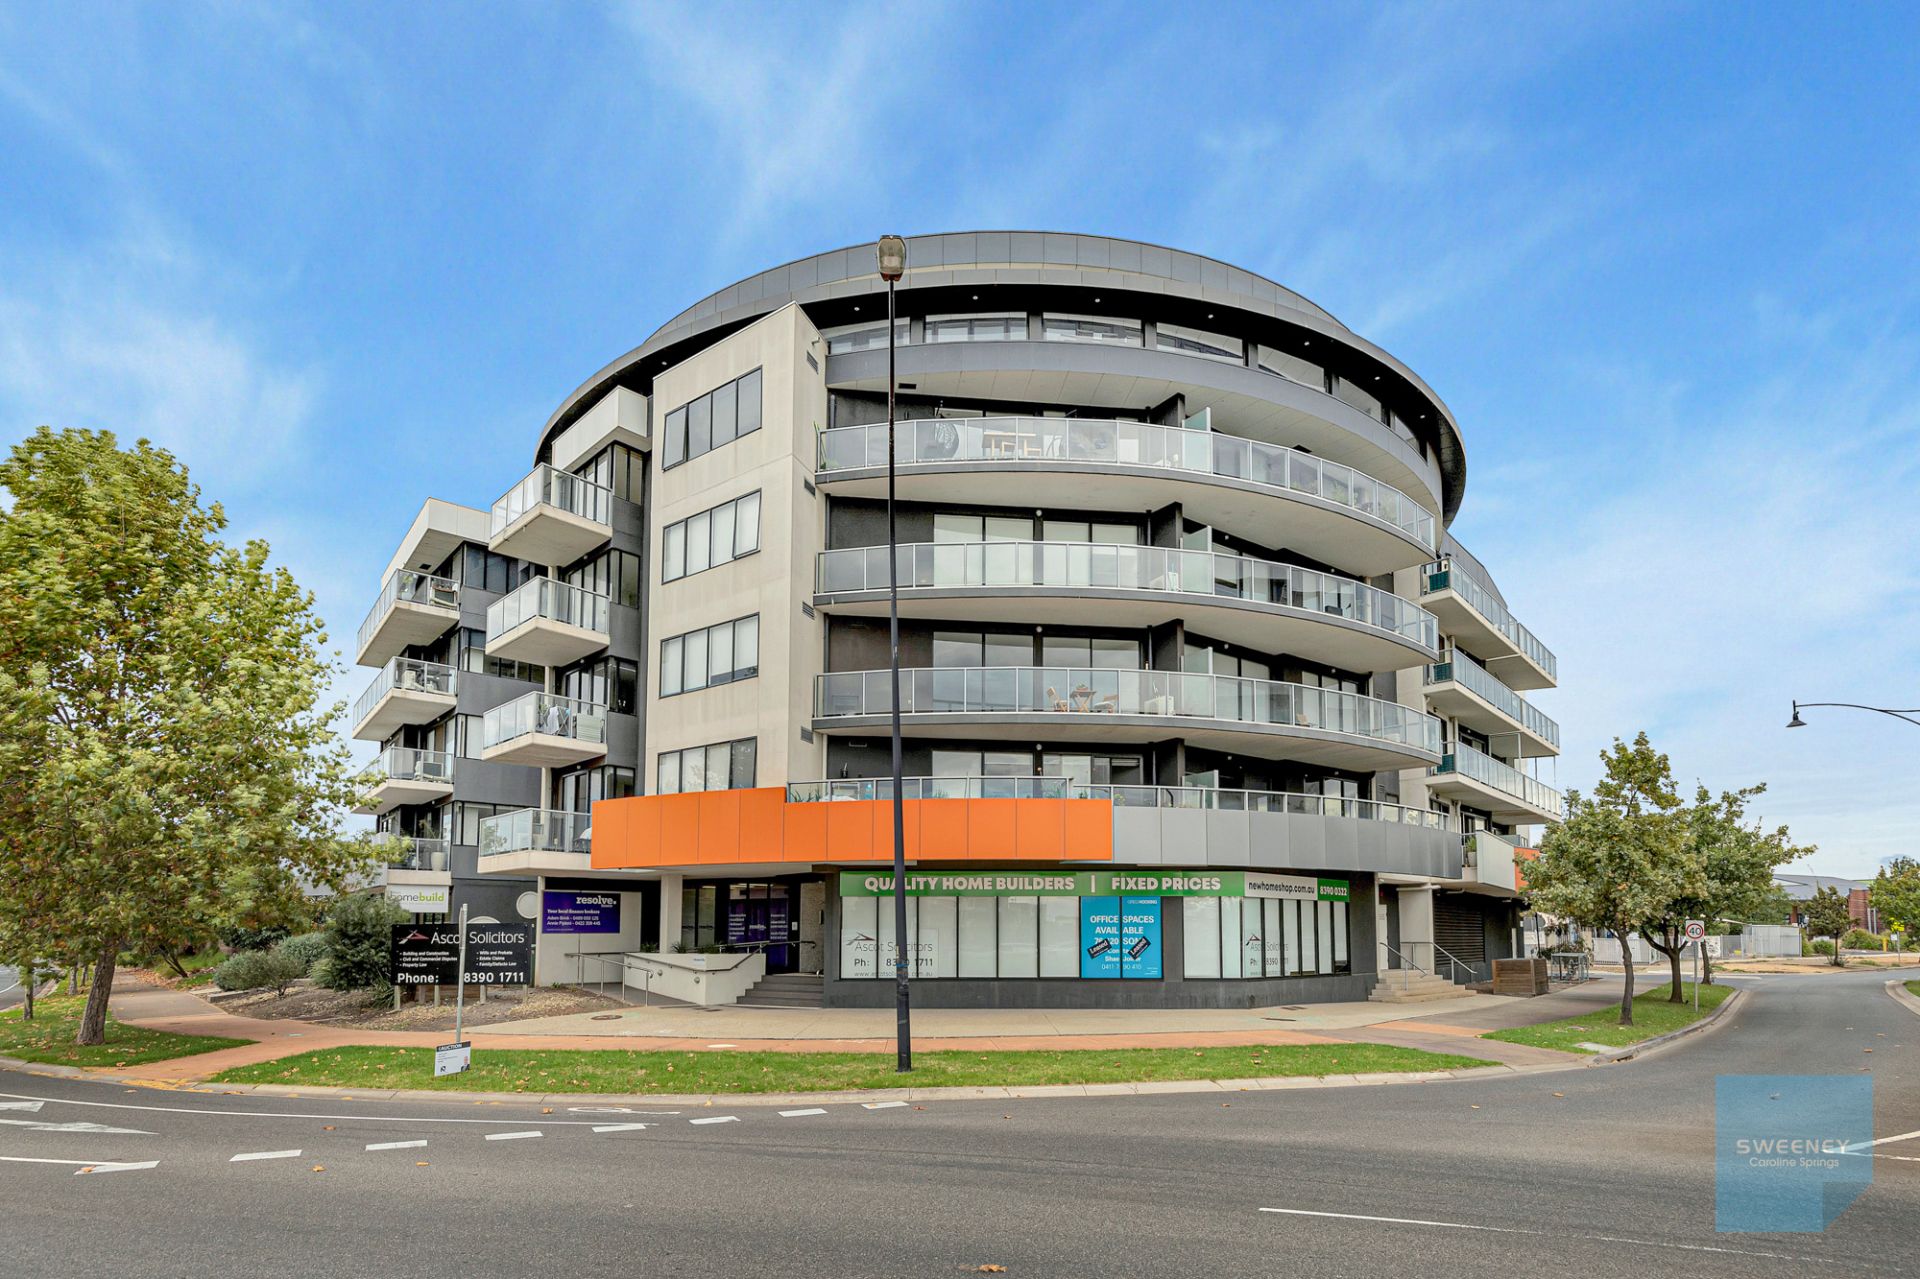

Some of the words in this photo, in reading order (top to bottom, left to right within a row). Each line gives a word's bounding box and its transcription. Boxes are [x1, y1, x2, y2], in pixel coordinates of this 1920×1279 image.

[942, 877, 993, 891] HOME
[996, 877, 1075, 891] BUILDERS
[1111, 877, 1159, 891] FIXED
[1161, 877, 1221, 891] PRICES
[1248, 880, 1316, 895] newhomeshop.com.au
[1090, 915, 1119, 923] OFFICE
[1122, 915, 1155, 923] SPACES
[430, 931, 461, 945] Asco
[469, 931, 525, 944] Solicitors
[1689, 927, 1701, 936] 40
[854, 958, 870, 967] Ph:
[397, 972, 439, 984] Phone:
[463, 972, 494, 983] 8390
[499, 971, 524, 983] 1711
